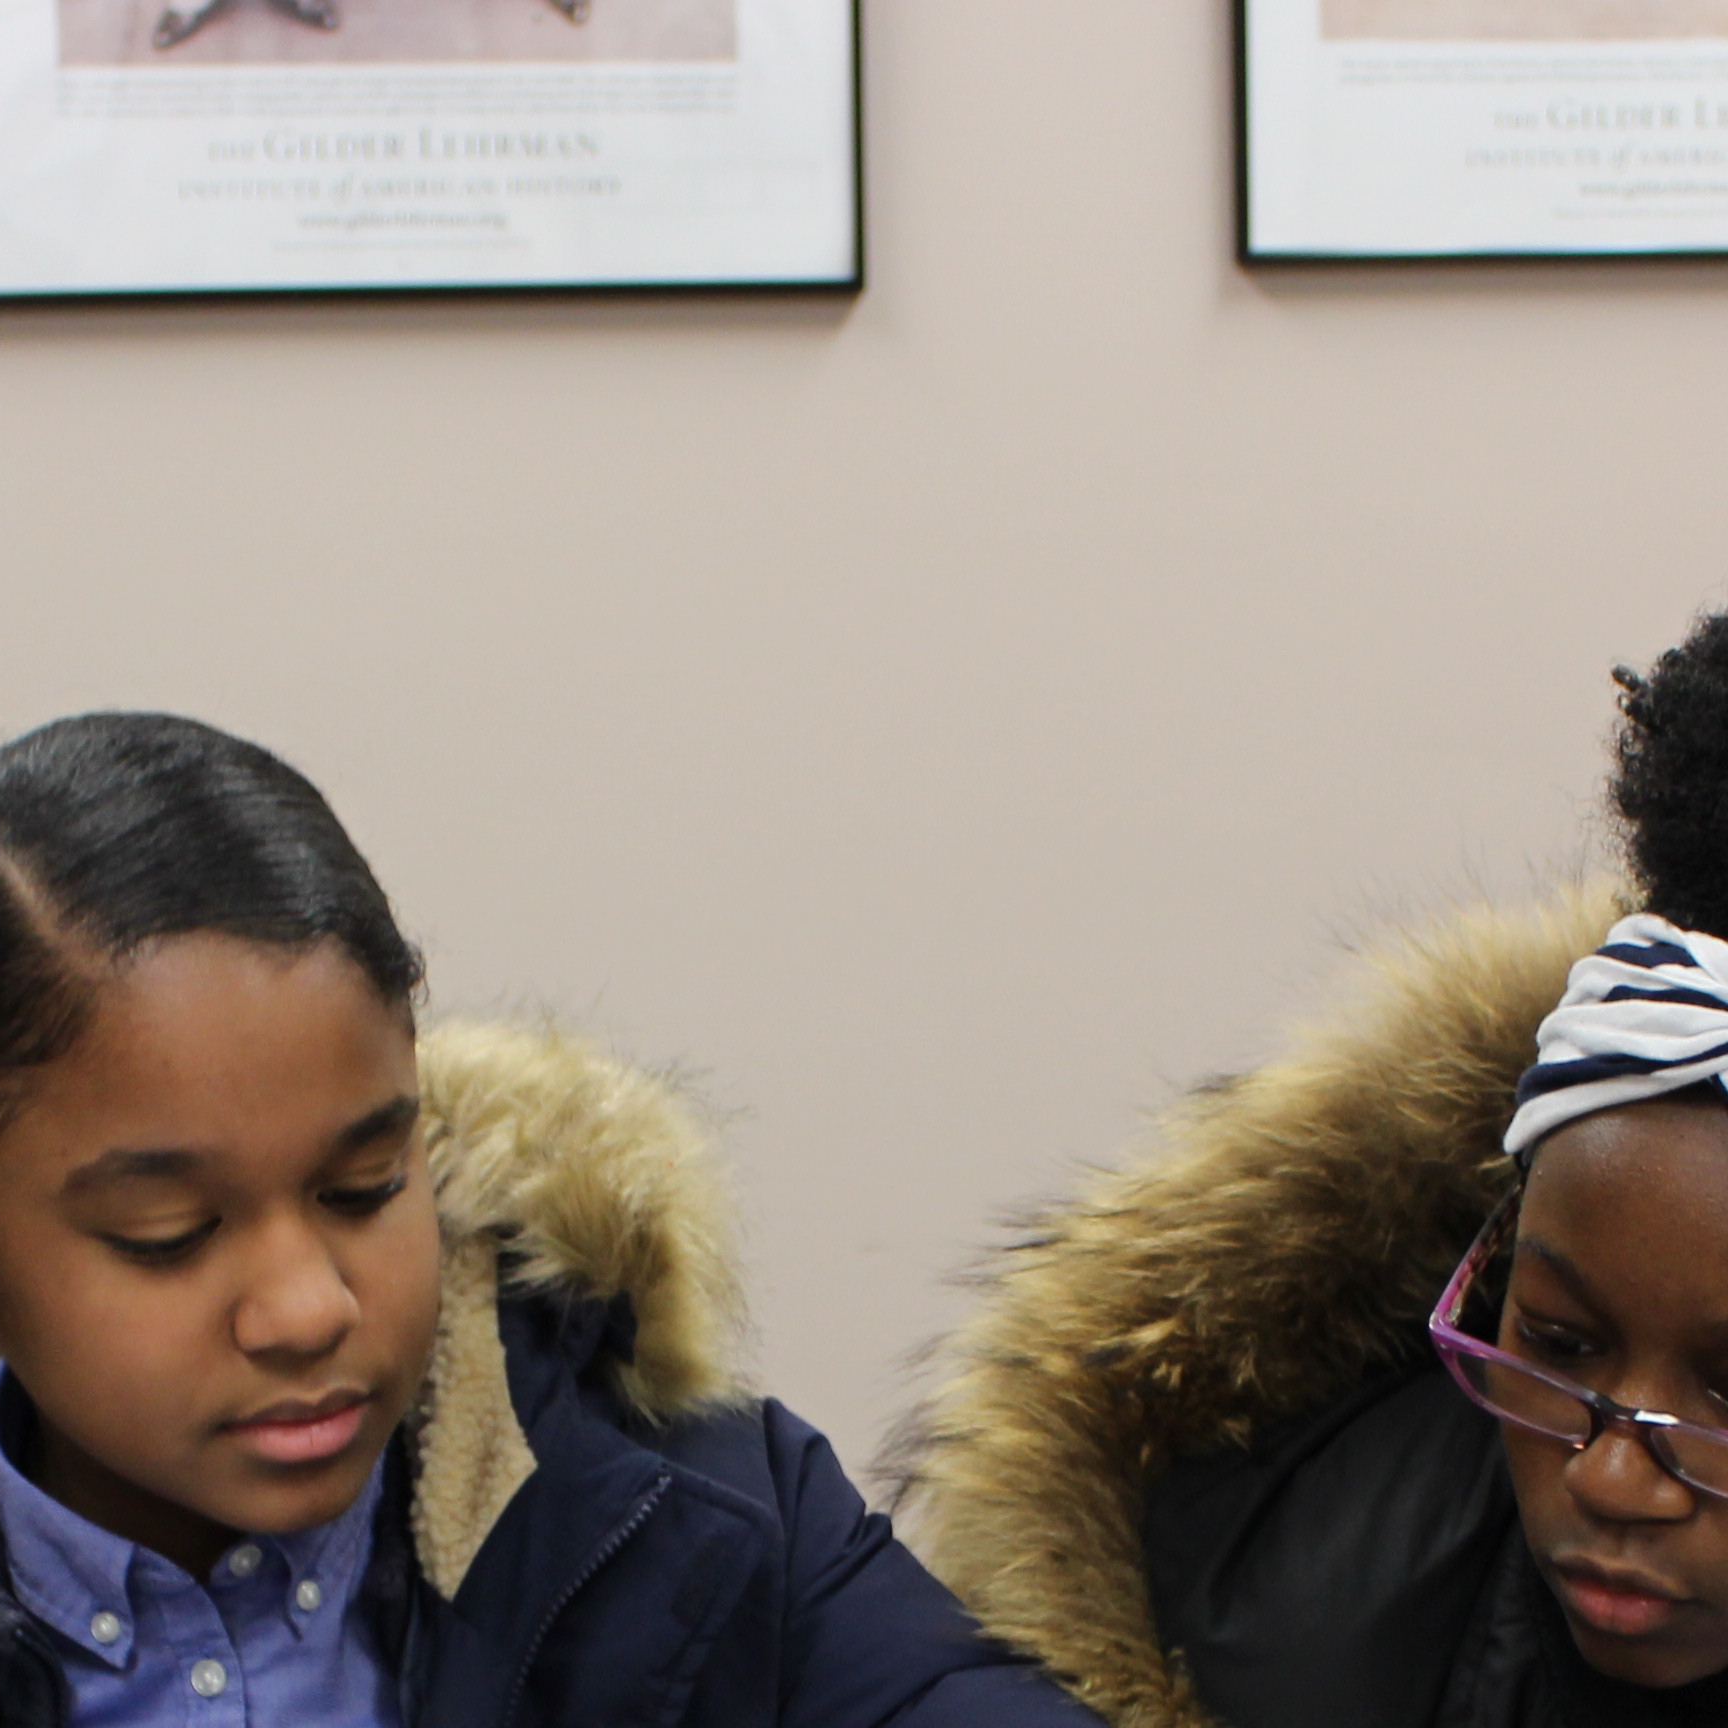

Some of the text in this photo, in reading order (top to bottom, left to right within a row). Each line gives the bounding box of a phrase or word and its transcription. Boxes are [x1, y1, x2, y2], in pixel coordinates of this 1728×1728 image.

[1546, 96, 1681, 131] GILDER
[262, 127, 404, 163] GILDER
[417, 124, 601, 161] LEHRMAN
